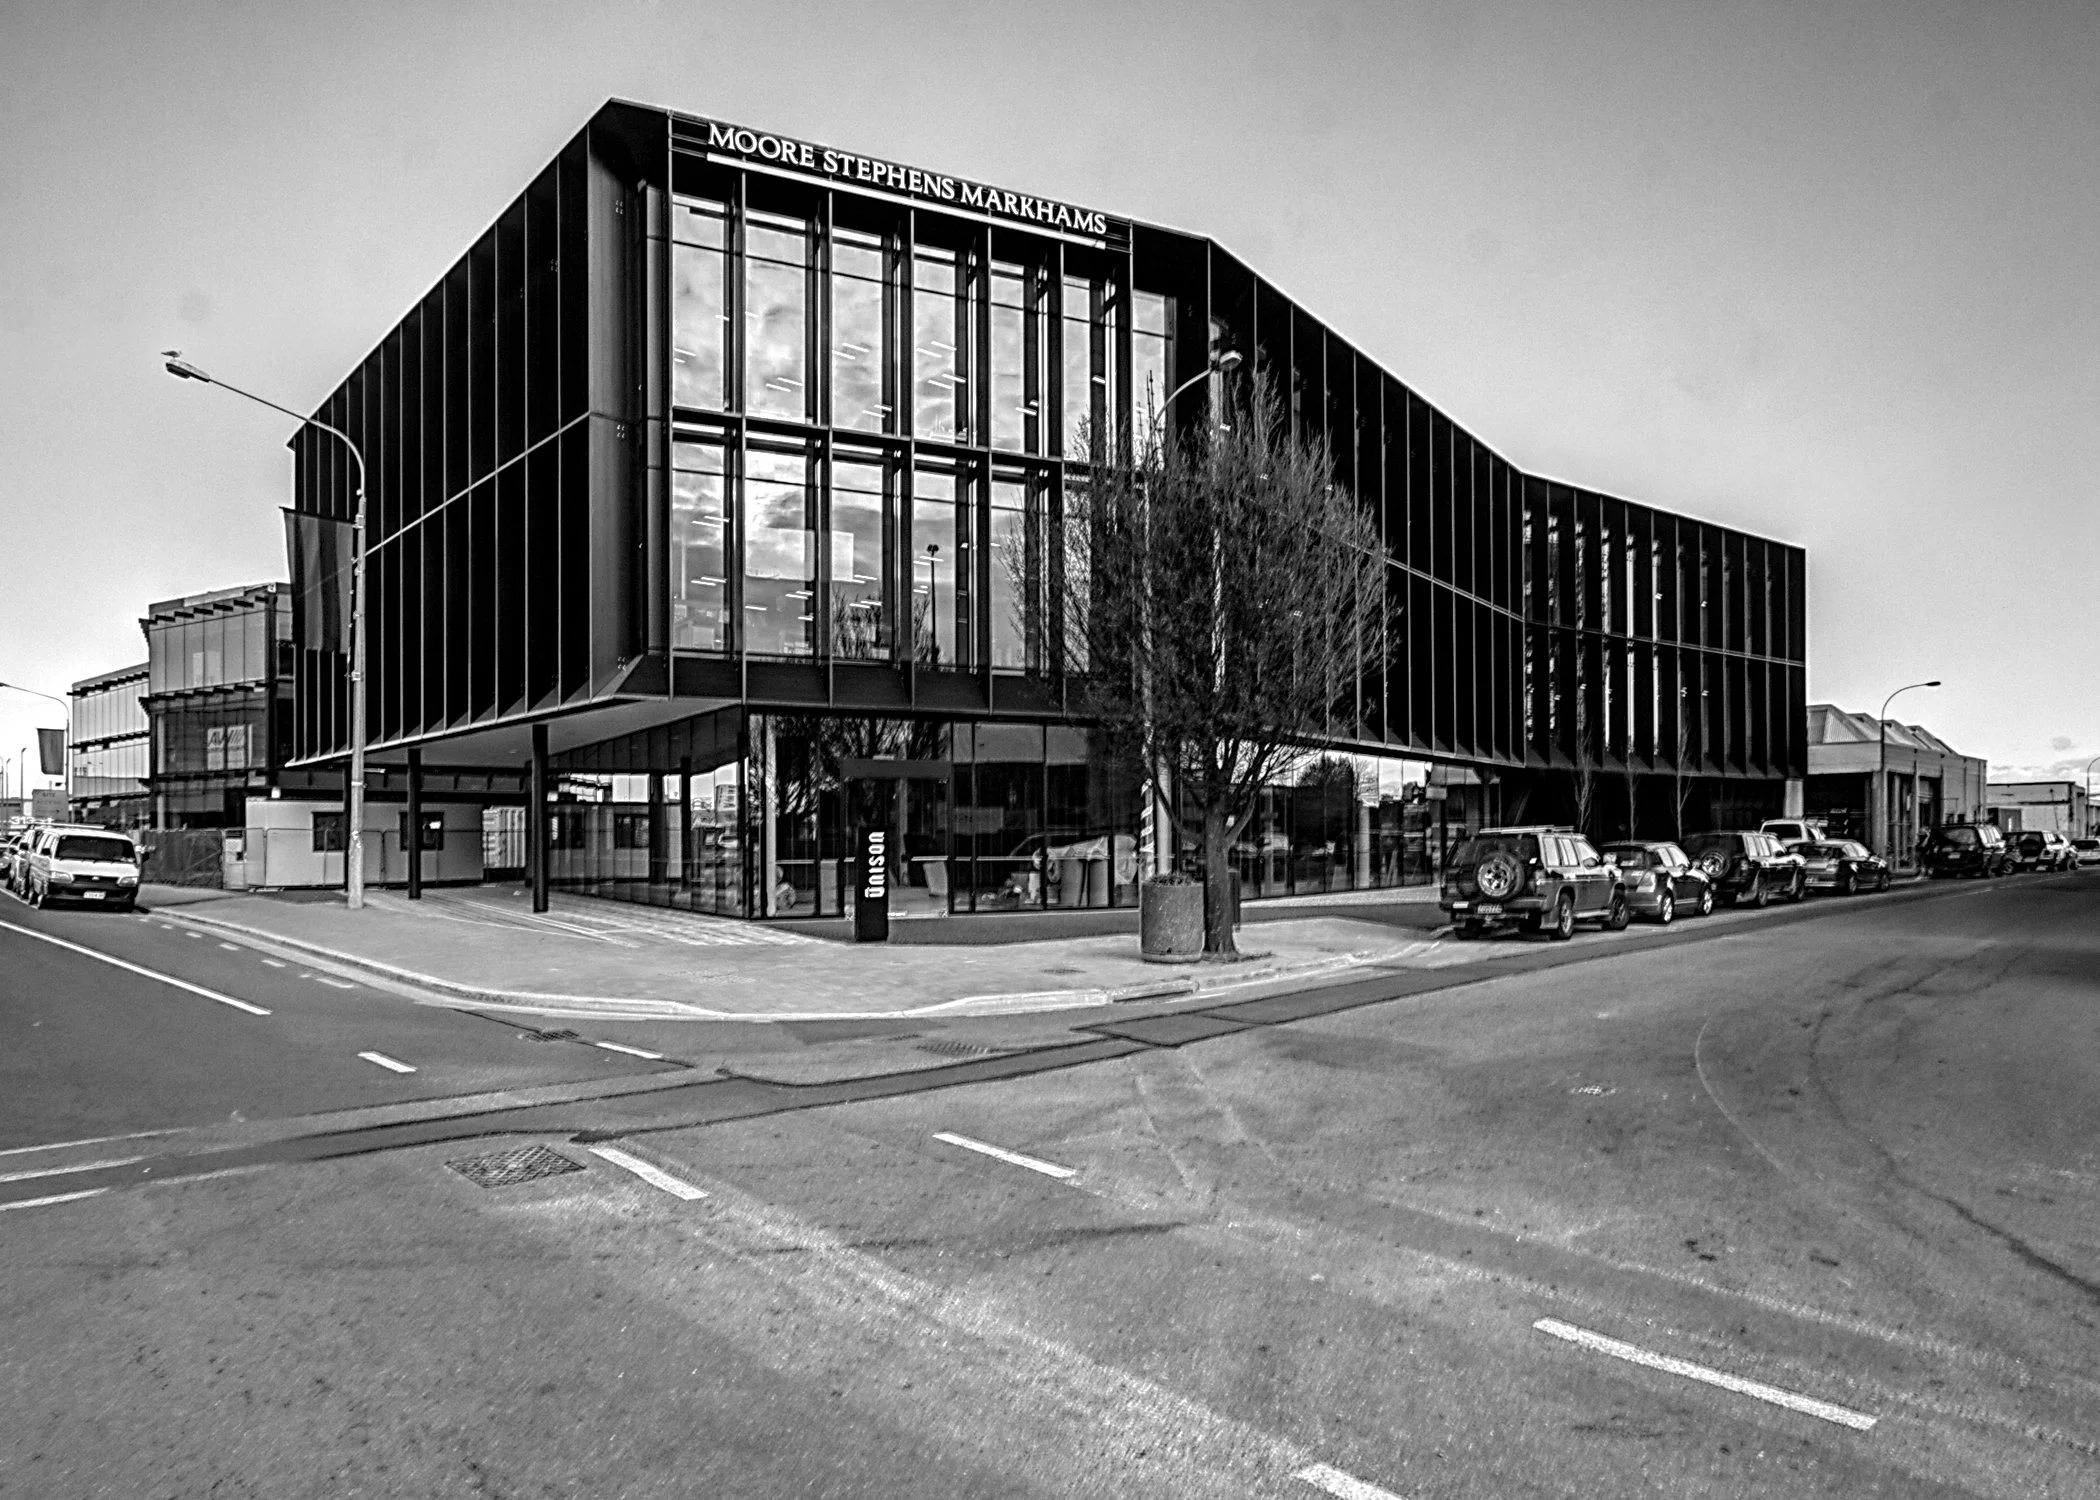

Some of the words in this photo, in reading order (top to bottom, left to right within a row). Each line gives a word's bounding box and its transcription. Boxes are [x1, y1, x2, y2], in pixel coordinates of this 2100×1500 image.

[708, 124, 815, 168] MOORE
[822, 150, 956, 200] STEPHENS
[961, 181, 1108, 236] MARKHAMS
